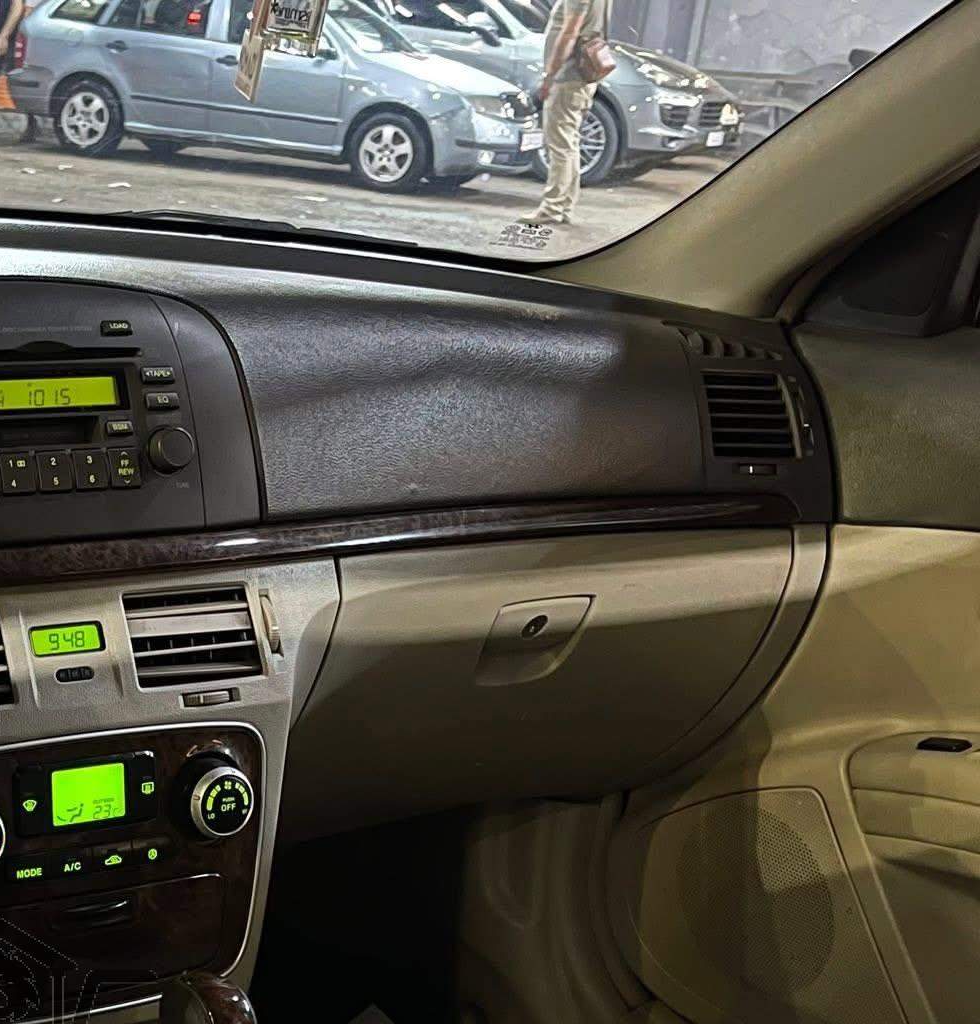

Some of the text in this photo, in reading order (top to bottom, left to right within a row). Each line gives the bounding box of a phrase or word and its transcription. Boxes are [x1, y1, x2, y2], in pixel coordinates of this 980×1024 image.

[50, 457, 57, 466] 2
[87, 455, 93, 464] 3
[11, 479, 17, 487] 4
[53, 477, 59, 485] 5
[89, 475, 95, 483] 6
[221, 802, 236, 812] OFF
[63, 861, 82, 872] A/C
[16, 867, 43, 879] MODE
